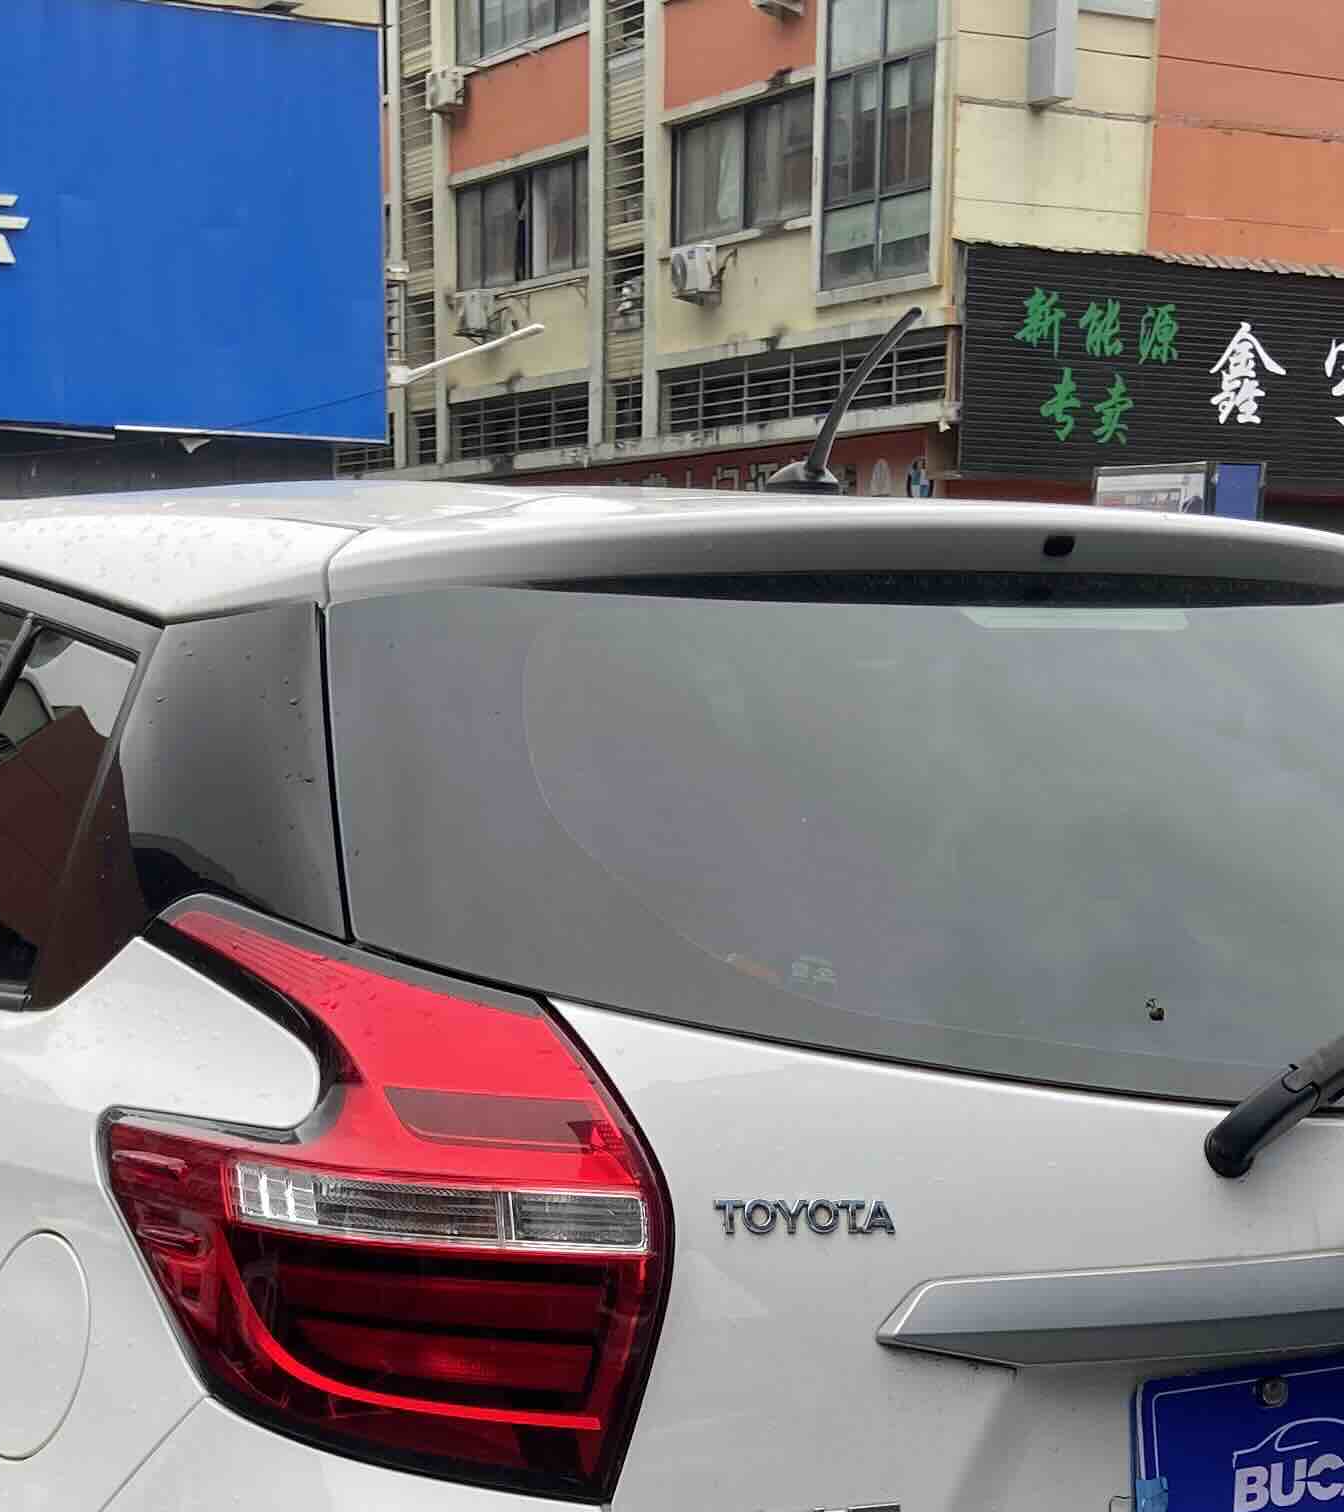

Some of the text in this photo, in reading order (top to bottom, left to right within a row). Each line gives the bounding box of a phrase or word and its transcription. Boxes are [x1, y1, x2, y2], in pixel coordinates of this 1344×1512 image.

[1009, 286, 1180, 365] 新能源
[1039, 367, 1134, 446] 专卖
[714, 1199, 896, 1234] TOYOTA
